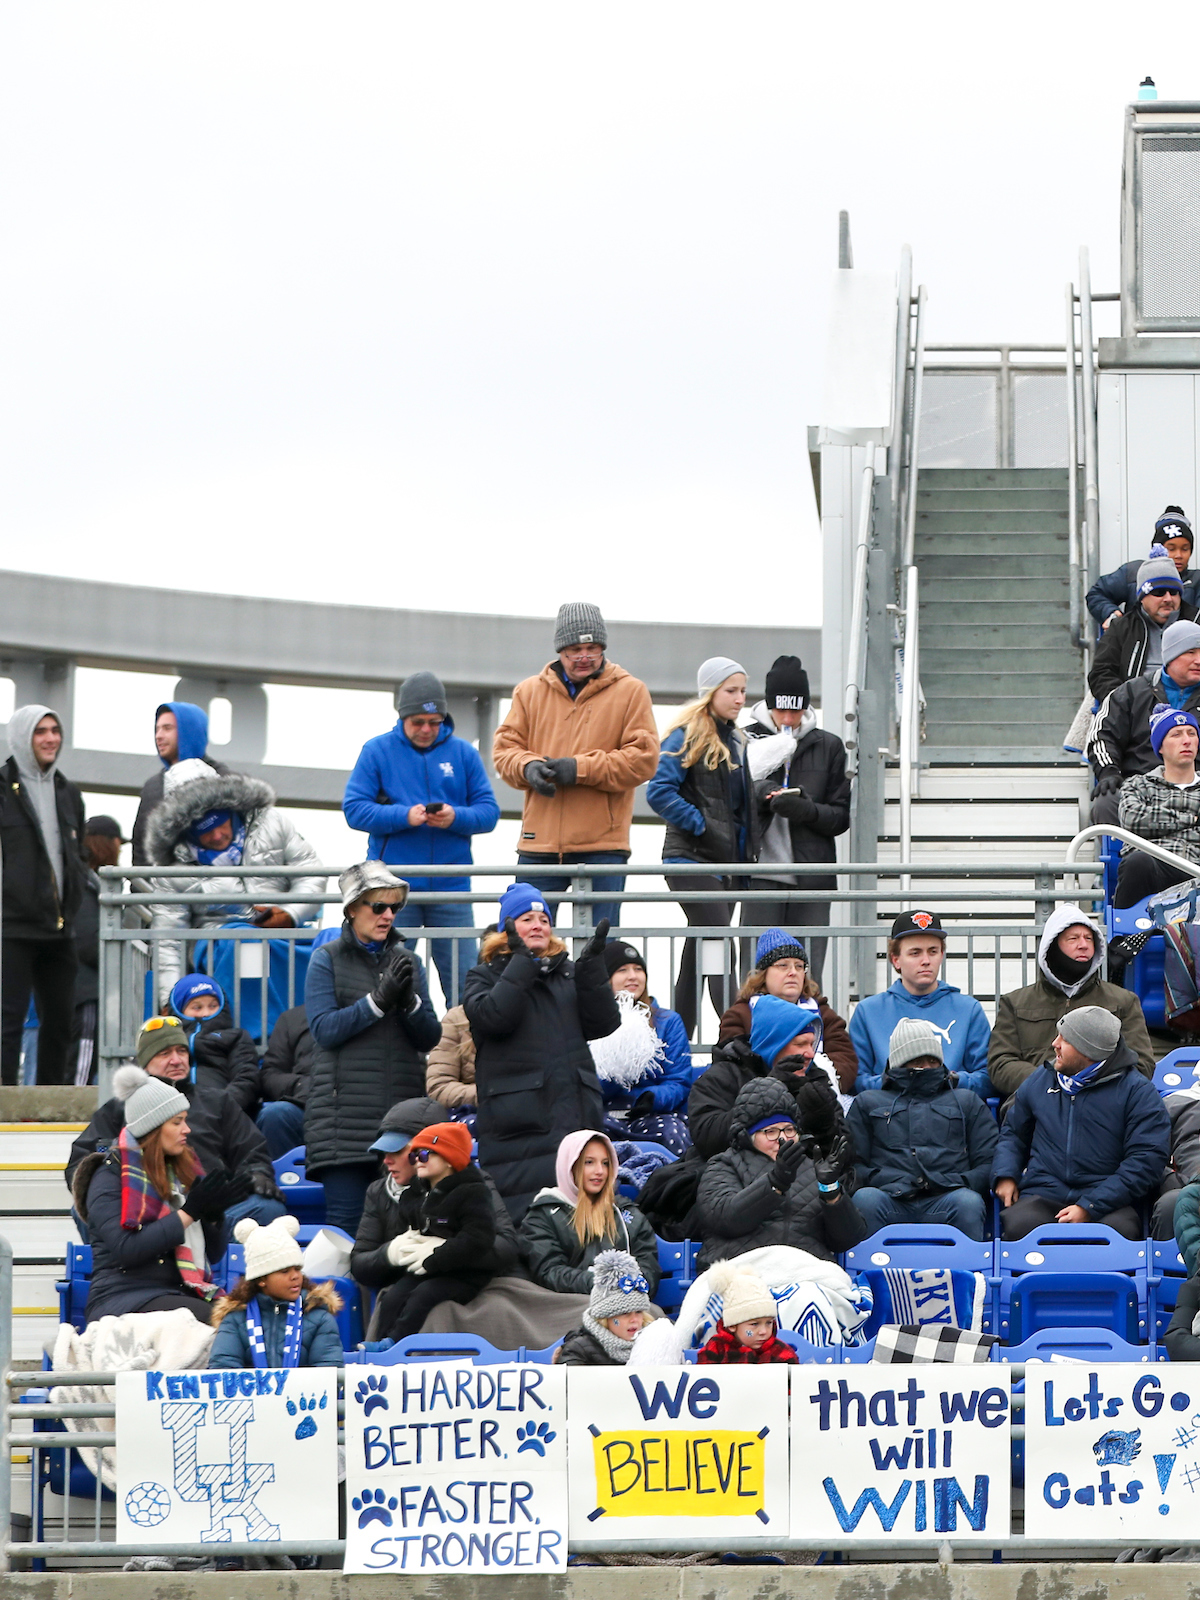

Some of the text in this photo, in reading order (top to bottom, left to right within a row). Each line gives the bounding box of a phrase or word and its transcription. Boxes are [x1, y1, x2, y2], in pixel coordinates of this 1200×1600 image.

[776, 695, 803, 711] BRKLN
[146, 1369, 290, 1401] KENTUCKY
[629, 1371, 720, 1421] We
[810, 1378, 1009, 1430] that we
[1044, 1372, 1191, 1427] Lets Go
[161, 1399, 281, 1543] UK
[603, 1438, 758, 1498] BELIEVE
[868, 1428, 953, 1471] will
[822, 1475, 990, 1533] WIN
[363, 1530, 562, 1569] STRONGER
